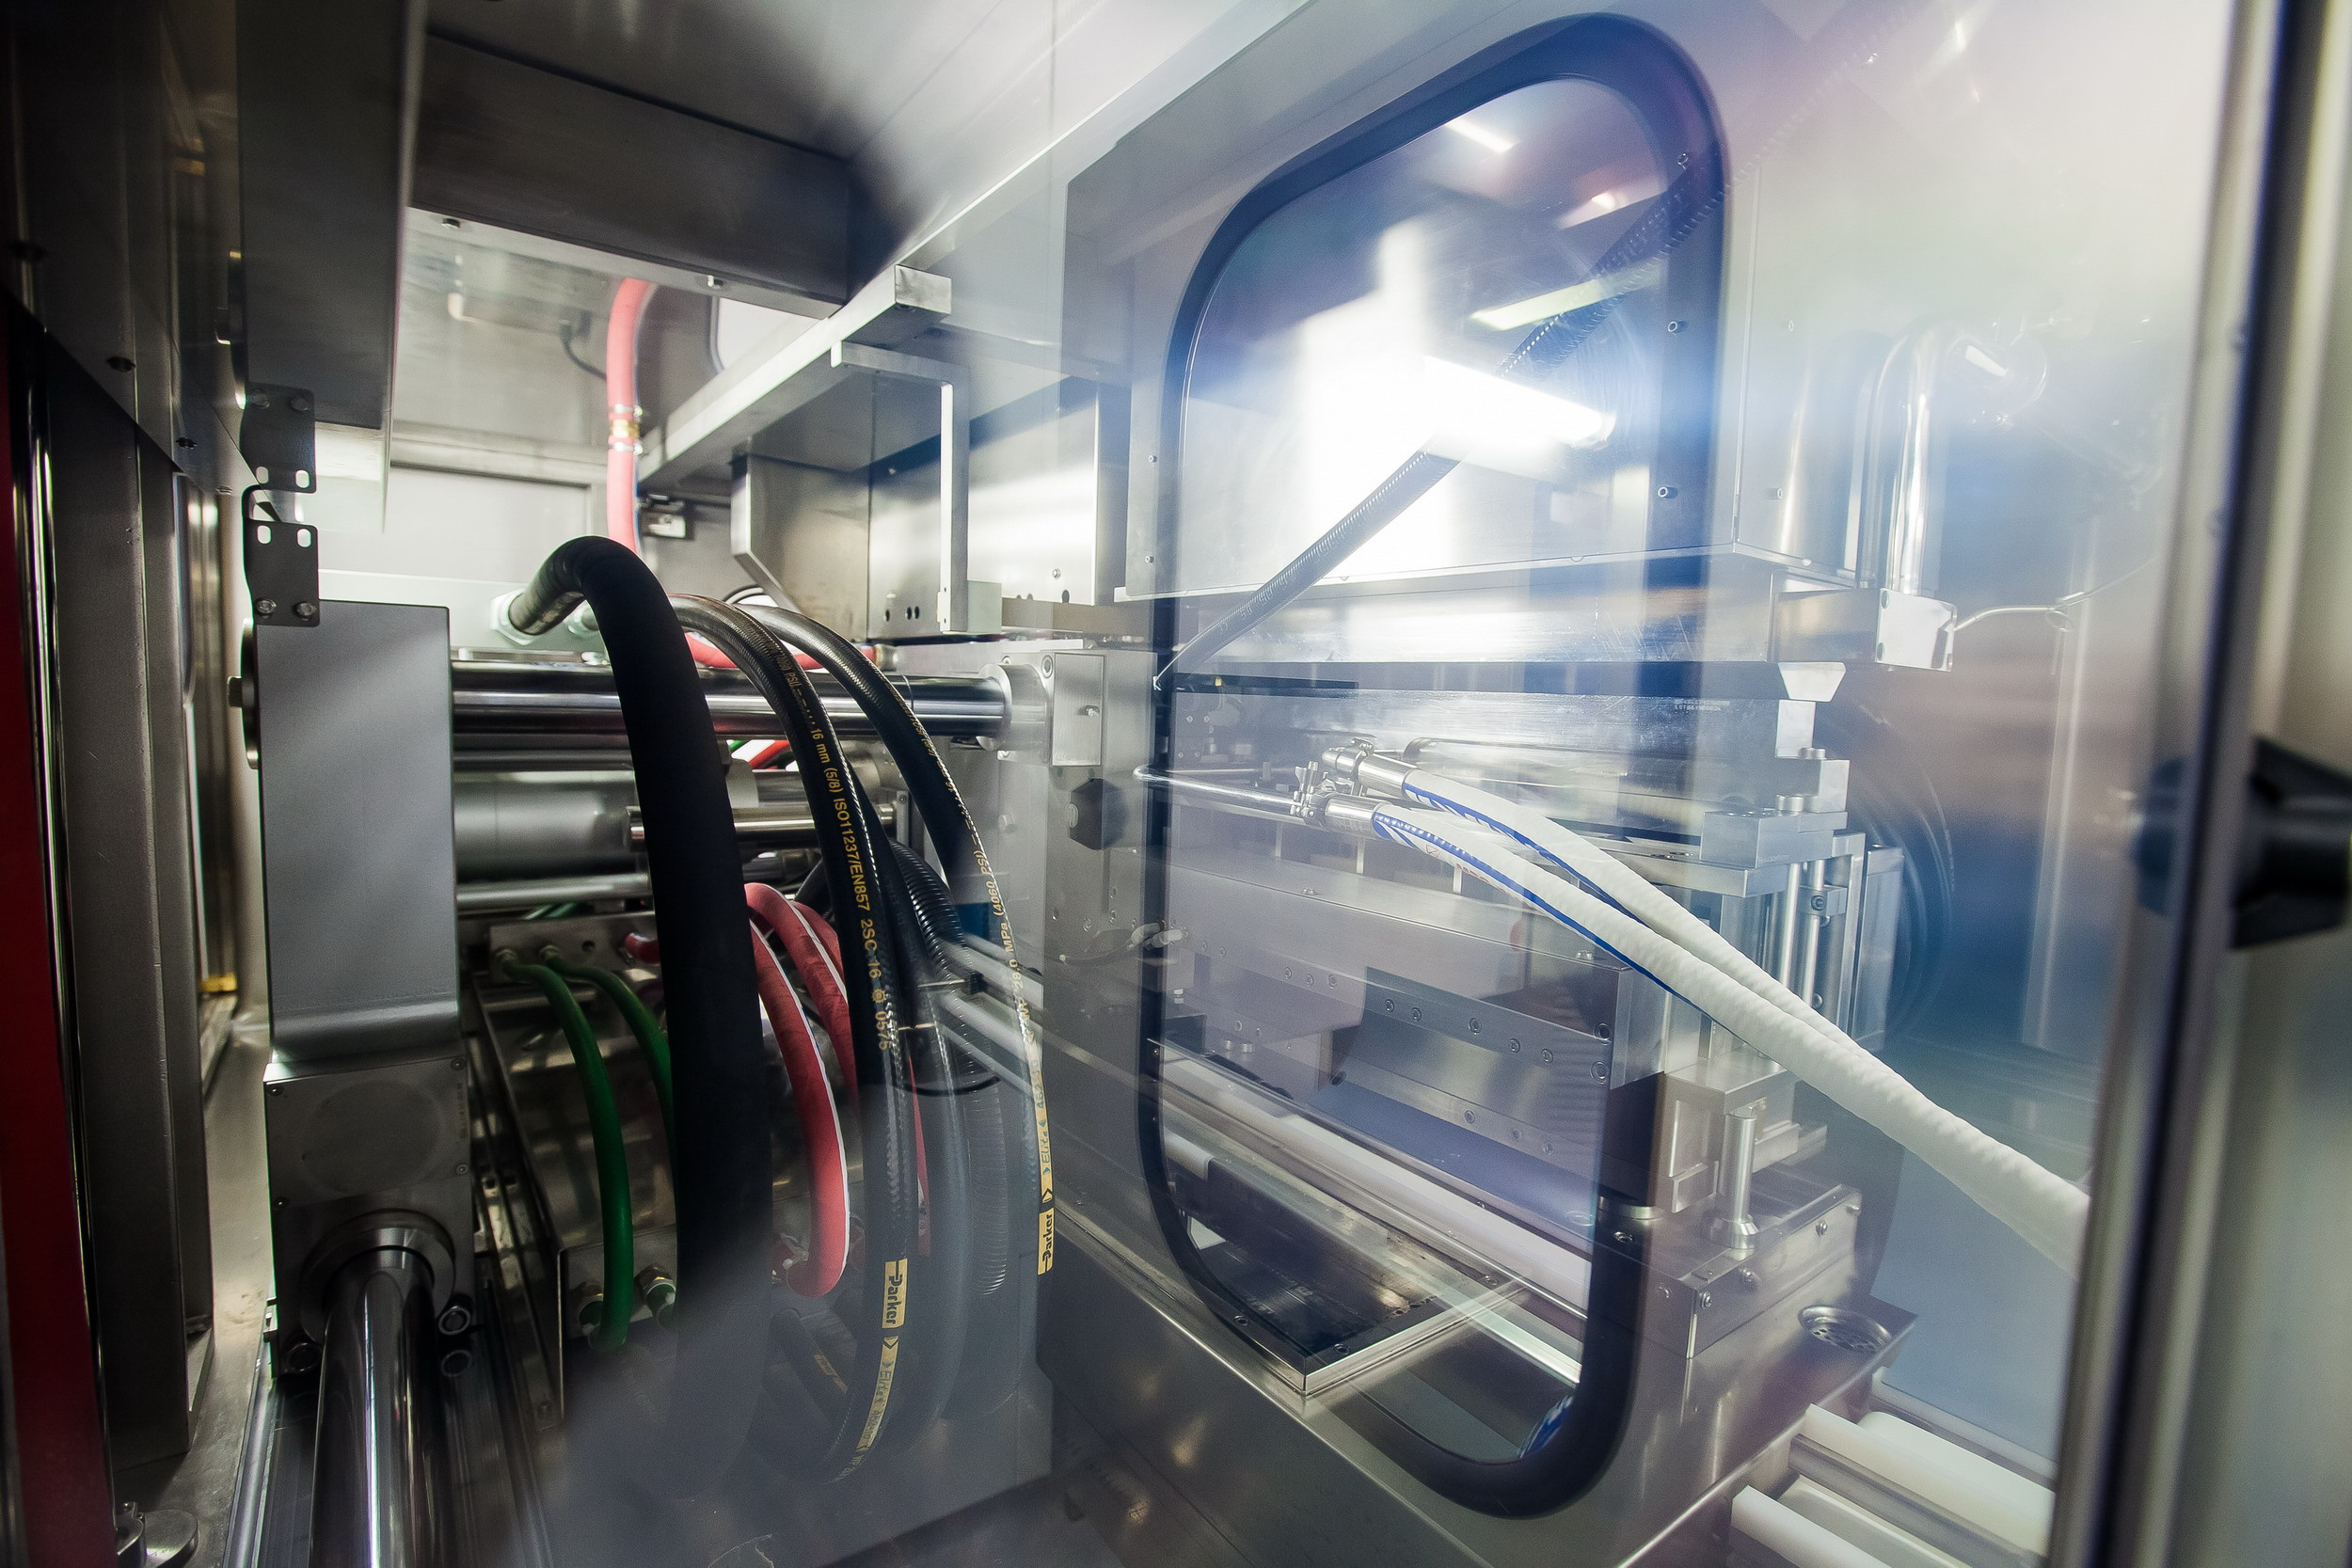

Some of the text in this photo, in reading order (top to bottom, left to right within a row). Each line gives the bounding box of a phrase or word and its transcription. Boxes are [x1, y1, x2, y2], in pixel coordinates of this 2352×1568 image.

[811, 728, 824, 741] 16
[816, 743, 831, 764] mm
[823, 768, 844, 794] (5/8)
[834, 798, 871, 912] ISO11237/EN857
[973, 849, 992, 876] PSI)
[986, 880, 1005, 917] (4060
[860, 918, 878, 952] 2SC
[1000, 922, 1014, 953] MPa
[867, 960, 882, 979] 16
[1041, 1130, 1051, 1164] Elite
[1041, 1213, 1053, 1272] Parker
[885, 1261, 903, 1325] Parker
[875, 1370, 892, 1397] Elite
